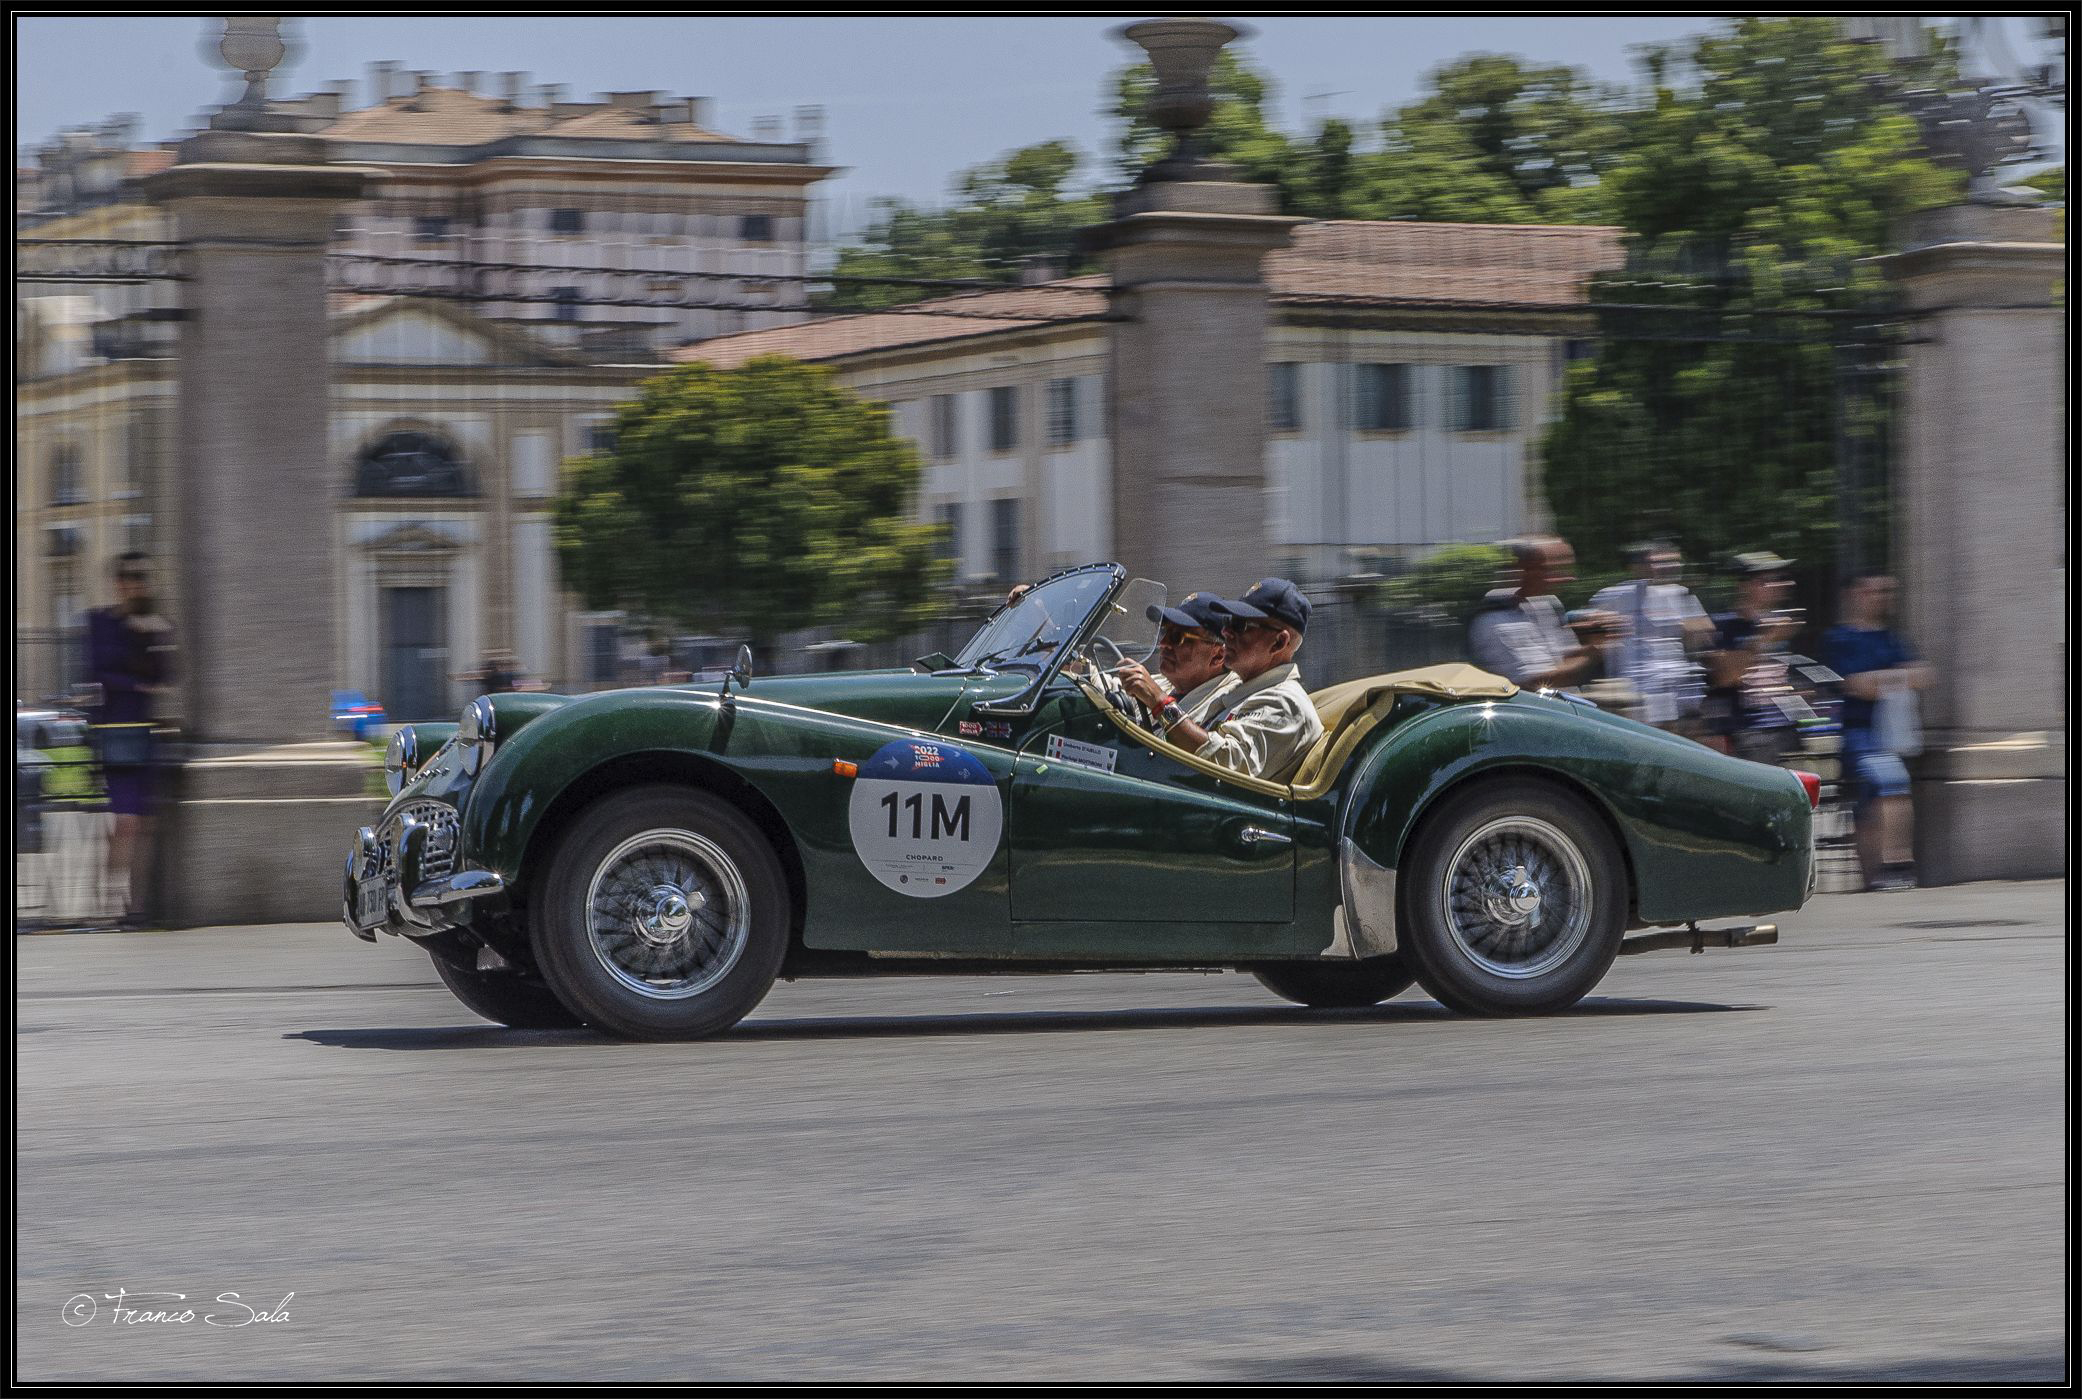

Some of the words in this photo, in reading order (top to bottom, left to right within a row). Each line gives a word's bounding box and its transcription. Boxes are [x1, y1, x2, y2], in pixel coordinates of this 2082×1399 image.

[914, 745, 940, 756] 2022
[881, 791, 971, 842] 11M
[906, 854, 944, 862] CHOPARD
